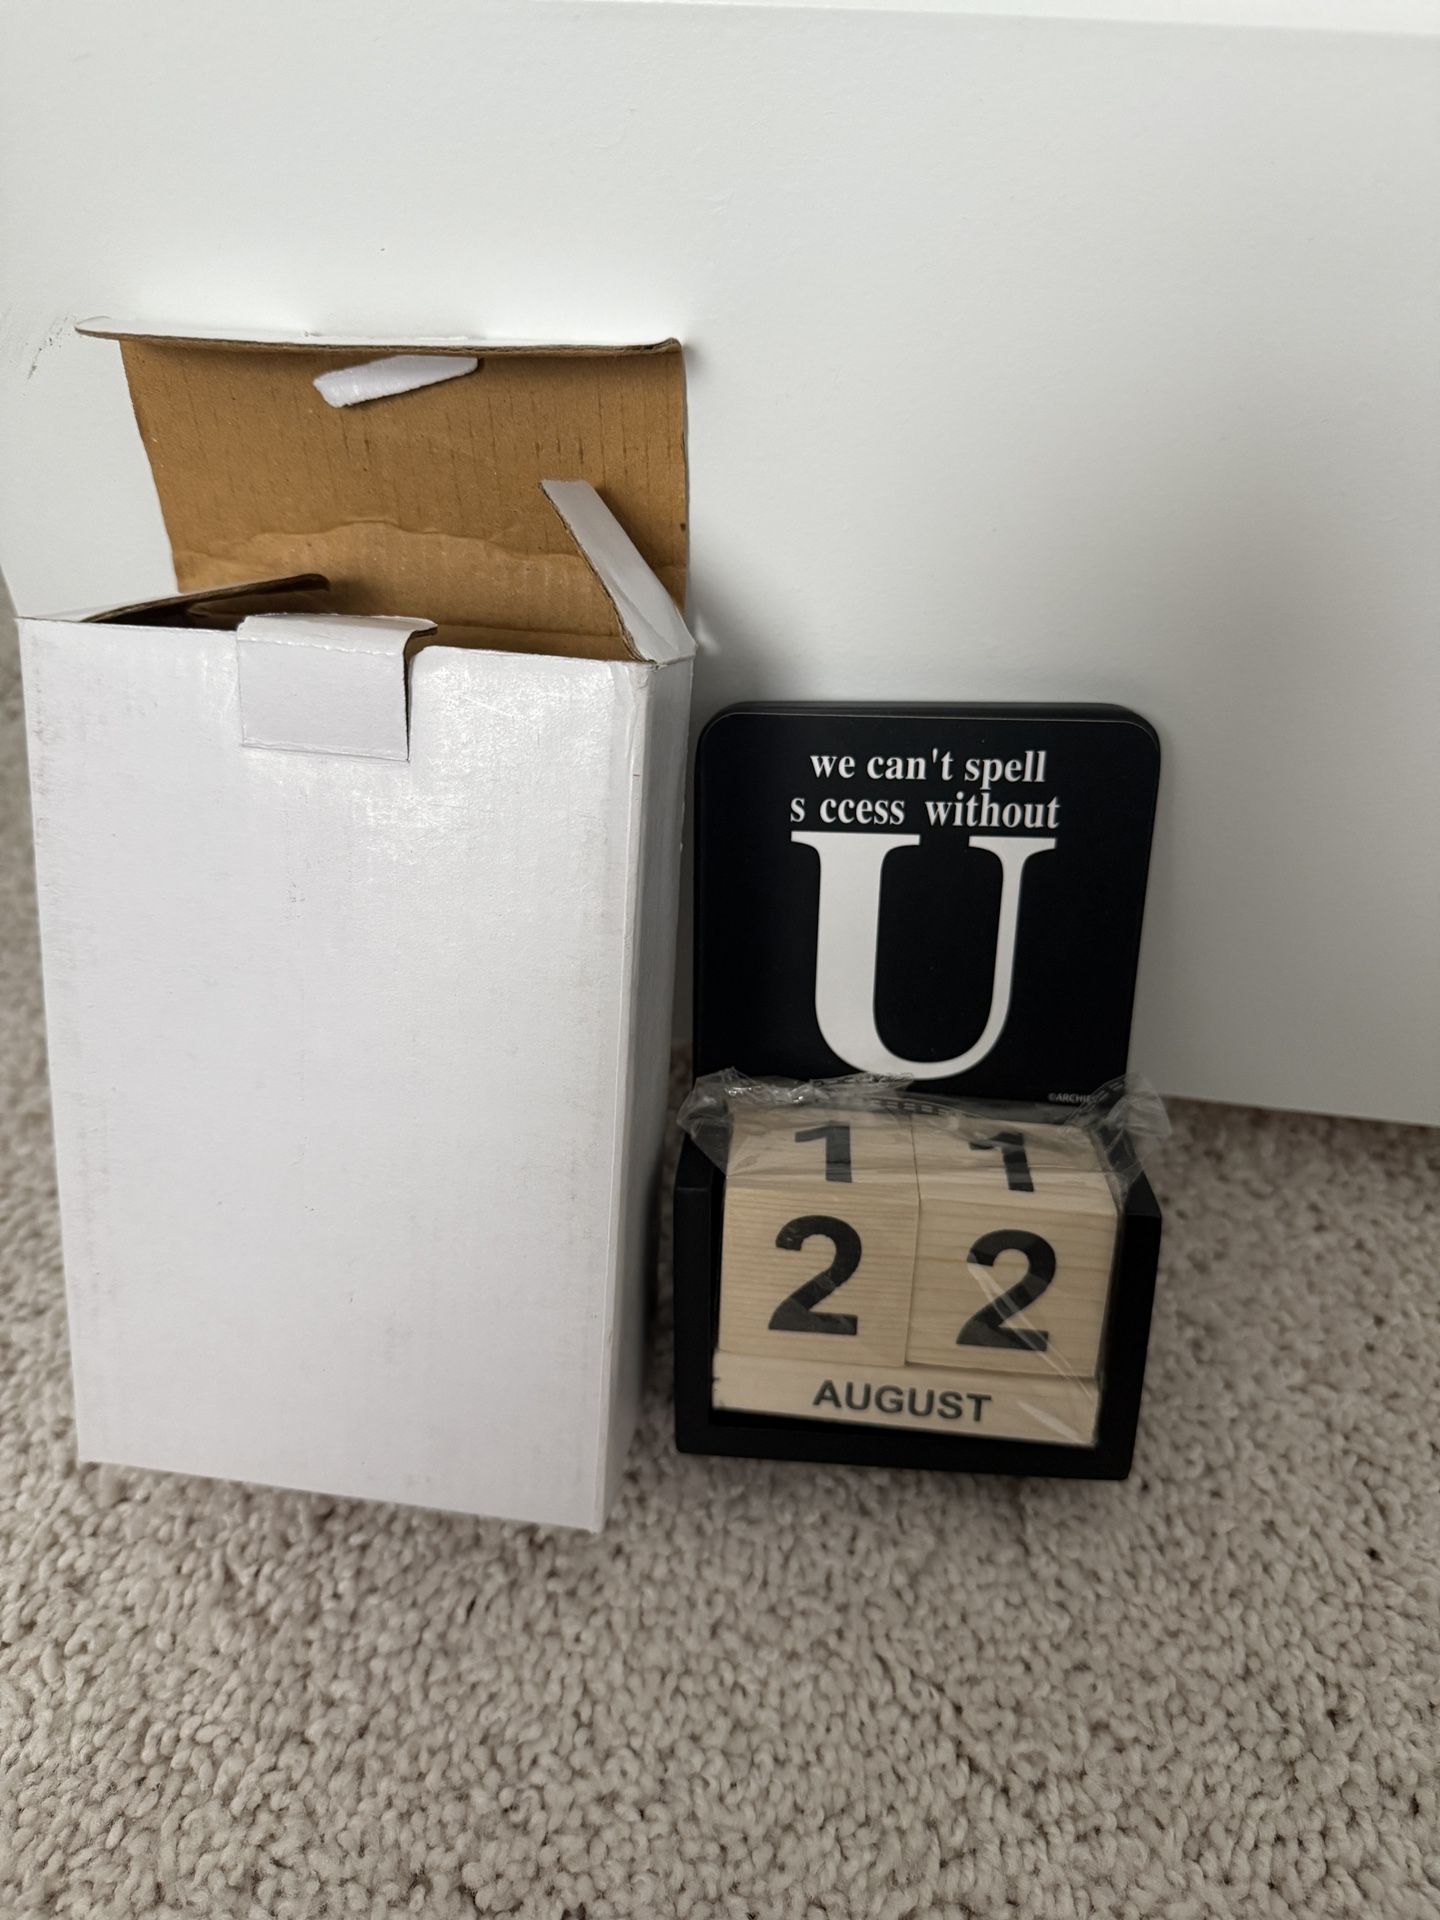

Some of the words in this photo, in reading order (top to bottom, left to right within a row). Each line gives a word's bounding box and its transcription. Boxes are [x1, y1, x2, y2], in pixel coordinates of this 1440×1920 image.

[809, 754, 856, 780] we
[866, 747, 954, 782] can't
[964, 750, 1047, 791] spell
[790, 796, 806, 824] s
[818, 797, 906, 826] ccess
[924, 791, 1061, 830] without
[790, 830, 1057, 1081] U
[795, 1121, 852, 1183] 1
[812, 1379, 994, 1425] AUGUST
